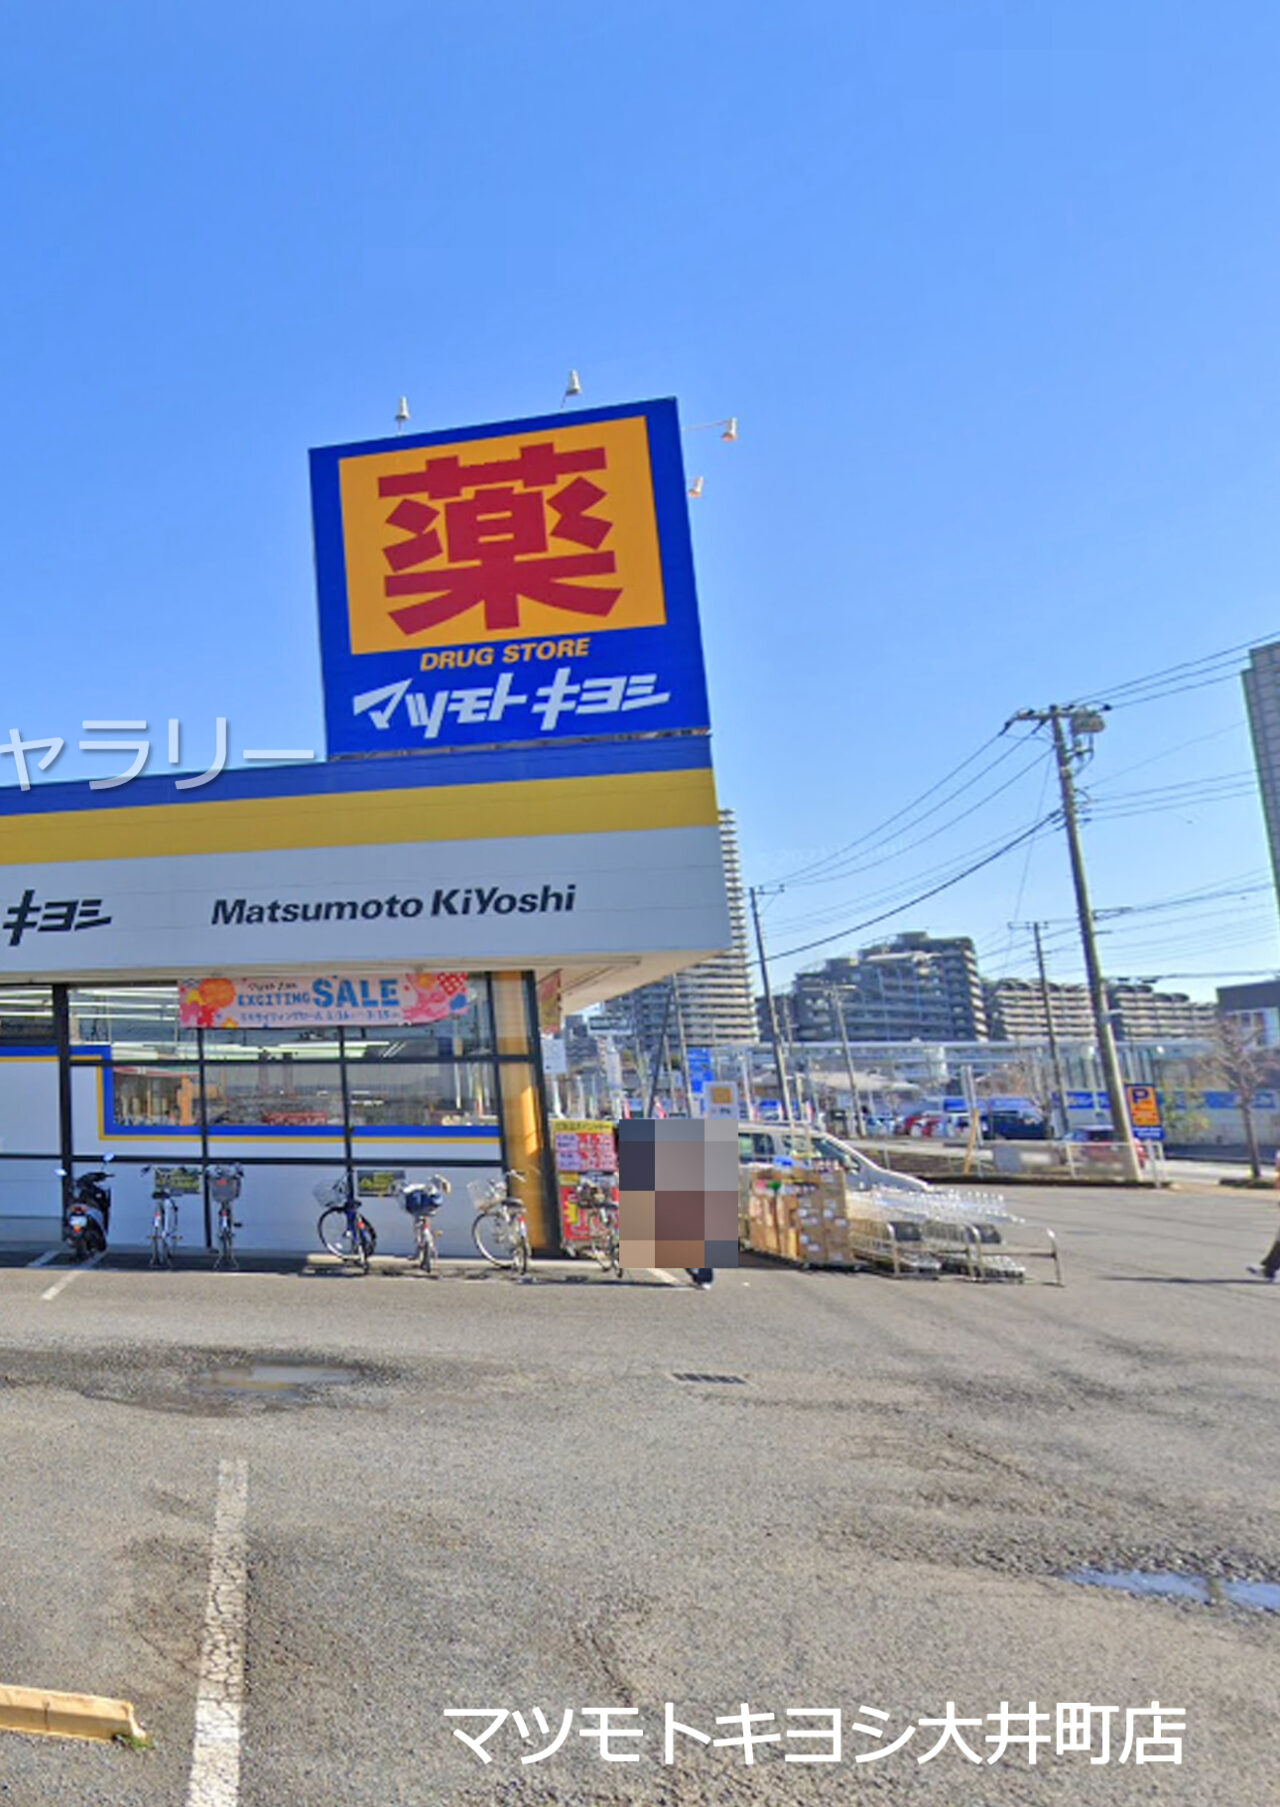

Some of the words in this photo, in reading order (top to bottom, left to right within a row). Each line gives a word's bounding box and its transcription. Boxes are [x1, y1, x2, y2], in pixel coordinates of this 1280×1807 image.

[378, 442, 624, 636] 薬
[420, 647, 494, 671] DRUG
[502, 637, 591, 663] STORE
[353, 667, 670, 739] マツモトキヨシ
[211, 893, 424, 925] Matsumoto
[430, 884, 577, 916] KiYoshi
[238, 991, 311, 1007] EXCITING
[312, 977, 401, 1008] SALE
[1132, 1088, 1149, 1104] P
